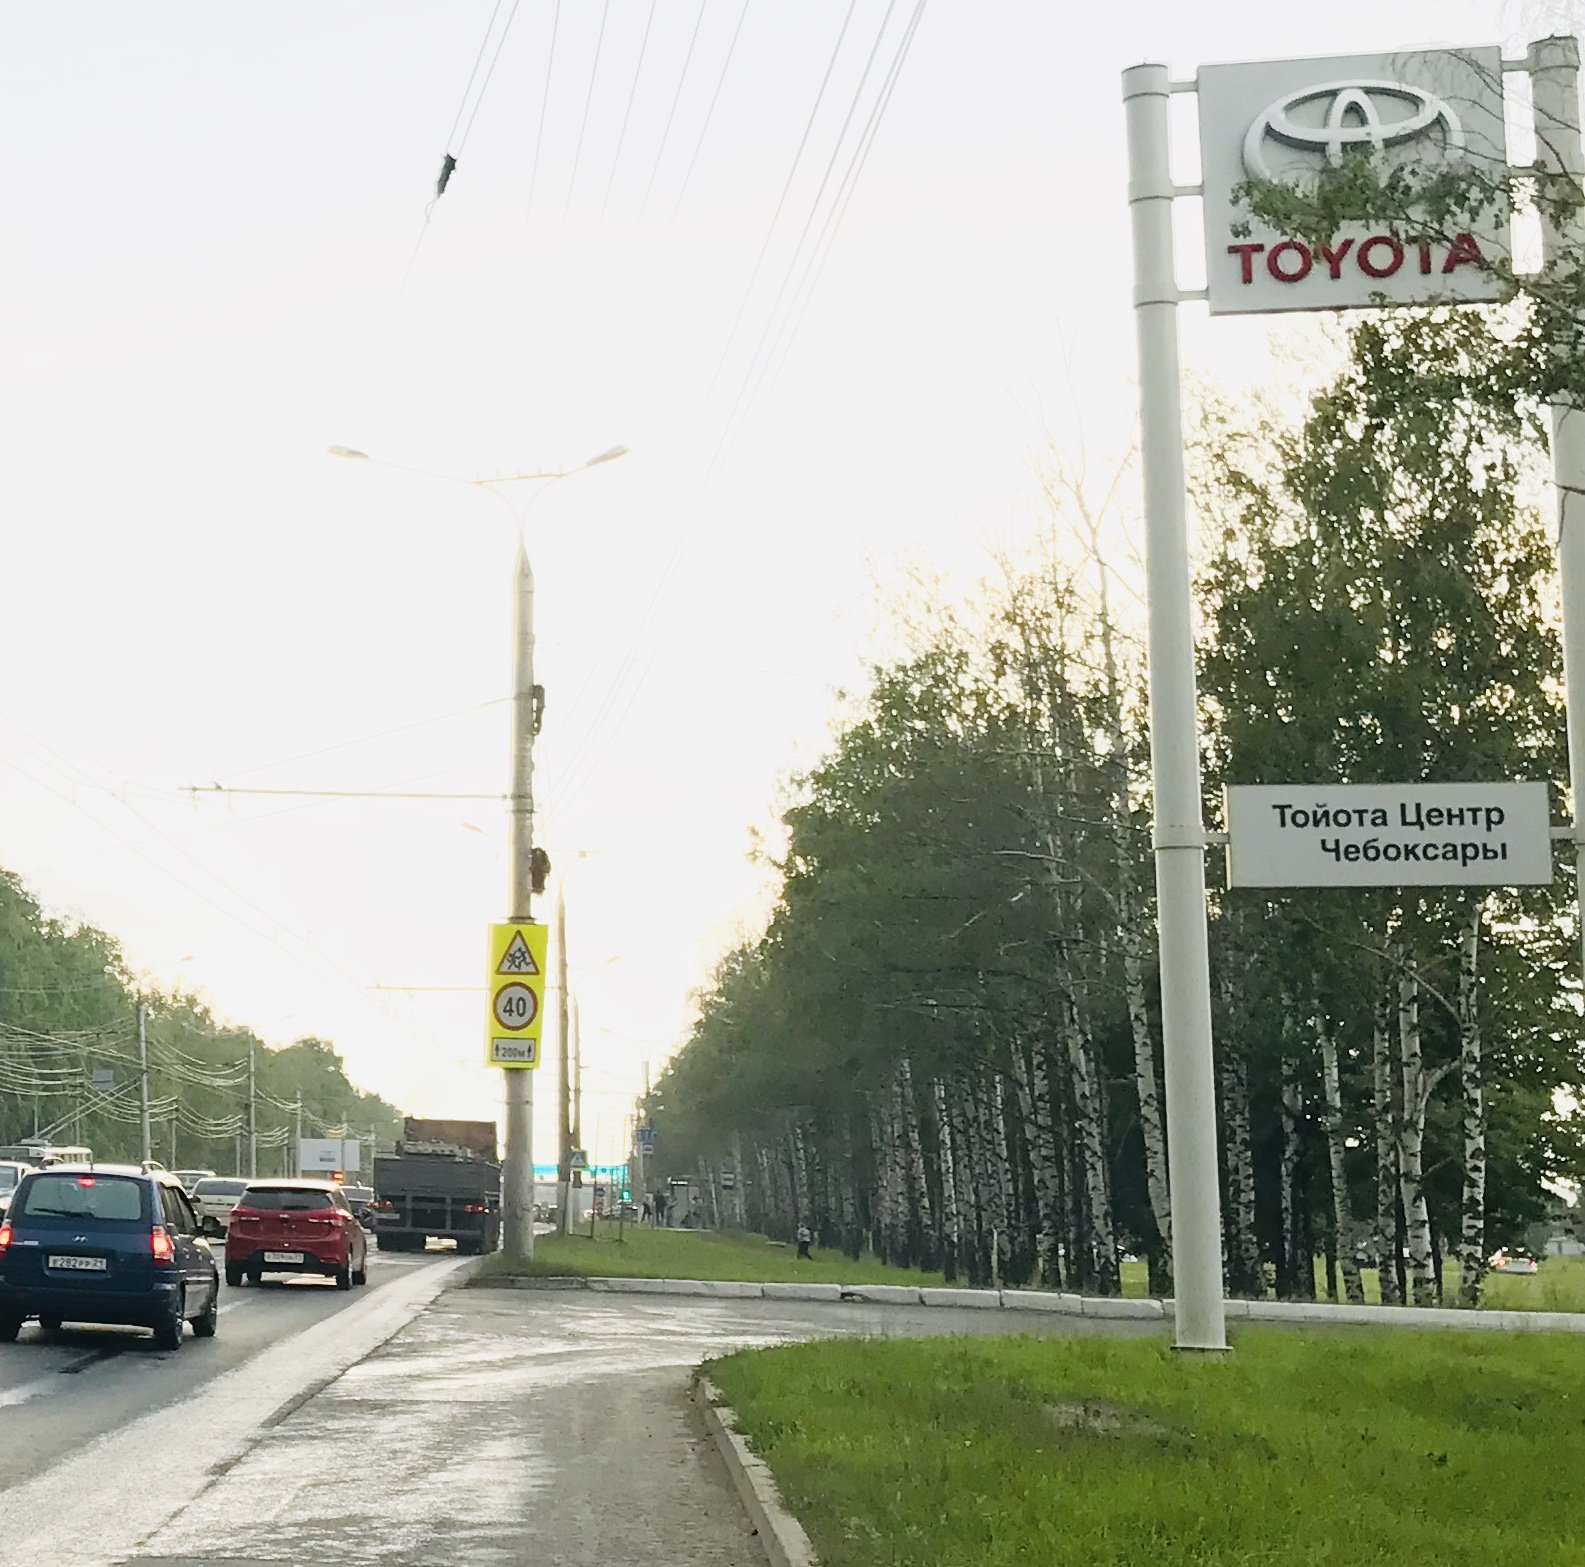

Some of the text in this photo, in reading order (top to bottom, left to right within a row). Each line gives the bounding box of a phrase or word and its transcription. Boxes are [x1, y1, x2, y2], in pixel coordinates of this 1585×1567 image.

[1227, 232, 1483, 284] TOYOTA
[1271, 802, 1505, 832] Тойота Центр
[1320, 837, 1508, 867] Чебоксары
[503, 996, 526, 1017] 40
